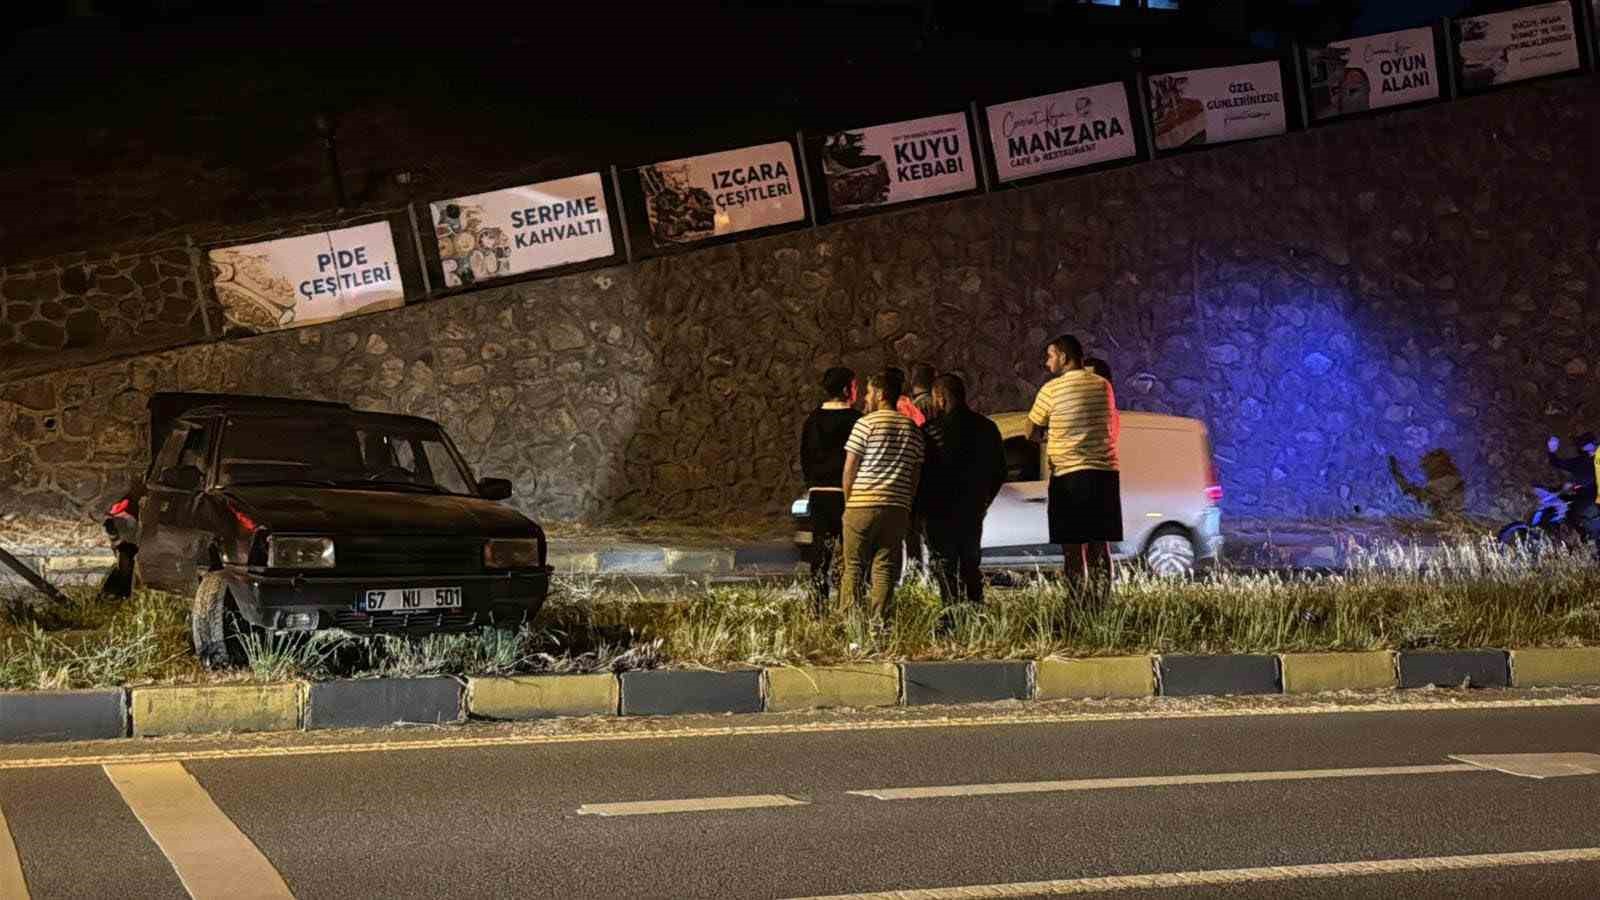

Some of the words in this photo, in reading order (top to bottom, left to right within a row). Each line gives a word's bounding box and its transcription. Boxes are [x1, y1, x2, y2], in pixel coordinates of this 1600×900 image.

[1380, 53, 1426, 75] OYUN
[1382, 71, 1429, 93] ALANI
[893, 134, 959, 165] KUYU
[1008, 117, 1124, 158] MANZARA
[711, 160, 789, 190] IZGARA
[897, 157, 963, 182] KEBABI
[715, 177, 792, 211] ÇEŞİTLERİ
[511, 196, 599, 228] SERPME
[514, 218, 602, 249] KAHVALTI
[367, 591, 386, 609] 67
[402, 590, 421, 608] NU
[435, 588, 460, 606] 501
